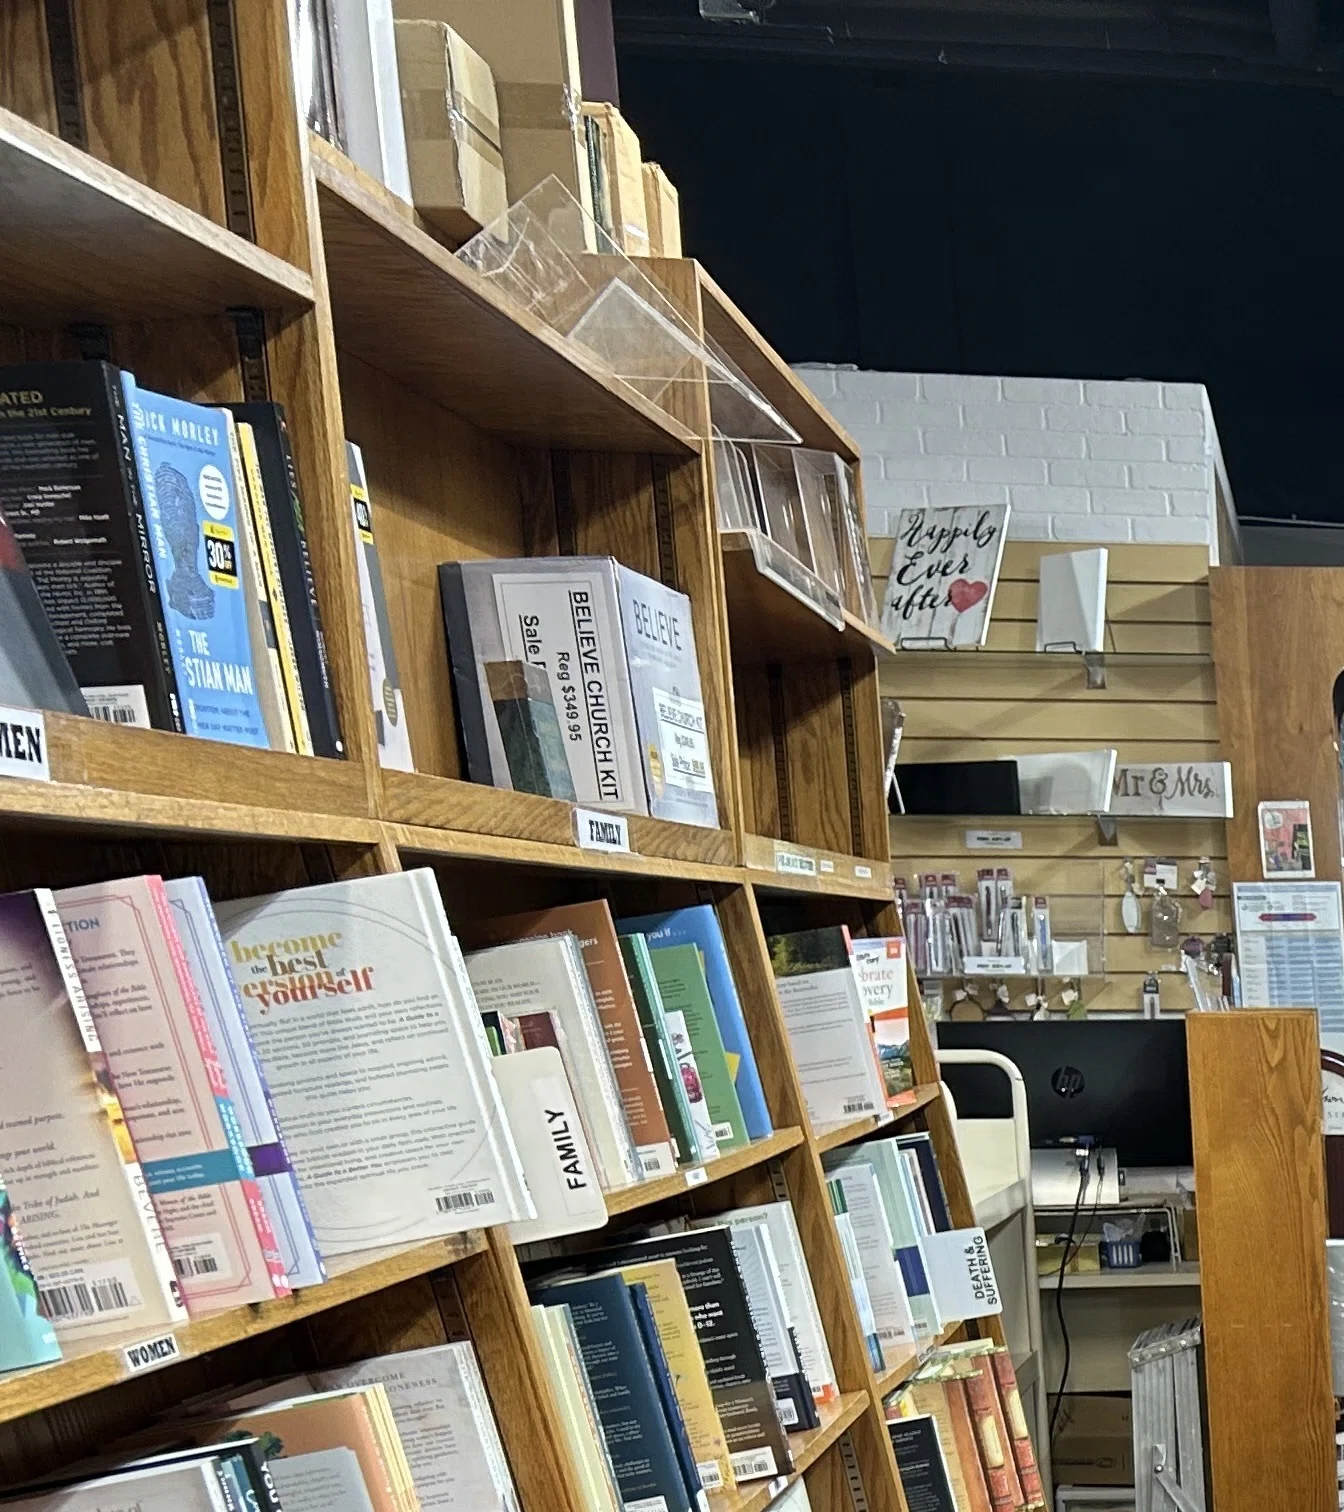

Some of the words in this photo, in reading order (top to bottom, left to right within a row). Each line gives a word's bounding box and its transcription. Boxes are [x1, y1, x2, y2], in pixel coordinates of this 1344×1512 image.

[172, 420, 220, 446] MORLEY
[117, 414, 131, 461] MAN
[136, 513, 156, 592] MIRROR
[900, 509, 1000, 553] Happily
[895, 553, 973, 587] Ever
[189, 632, 209, 656] THE
[568, 589, 599, 660] BELIEVE
[632, 598, 682, 652] BELIEVE
[223, 664, 252, 695] MAN
[555, 651, 573, 676] Reg
[561, 680, 583, 742] $349.95
[579, 666, 610, 749] CHURCH
[596, 753, 620, 800] KIT
[587, 820, 623, 846] FAMILY
[230, 931, 343, 966] become
[250, 964, 267, 976] the
[268, 950, 327, 978] best
[254, 966, 376, 1015] yourself
[545, 1107, 587, 1191] FAMILY
[966, 1257, 986, 1301] DEATH
[972, 1234, 998, 1306] SUFFERING
[127, 1337, 175, 1368] WOMEN
